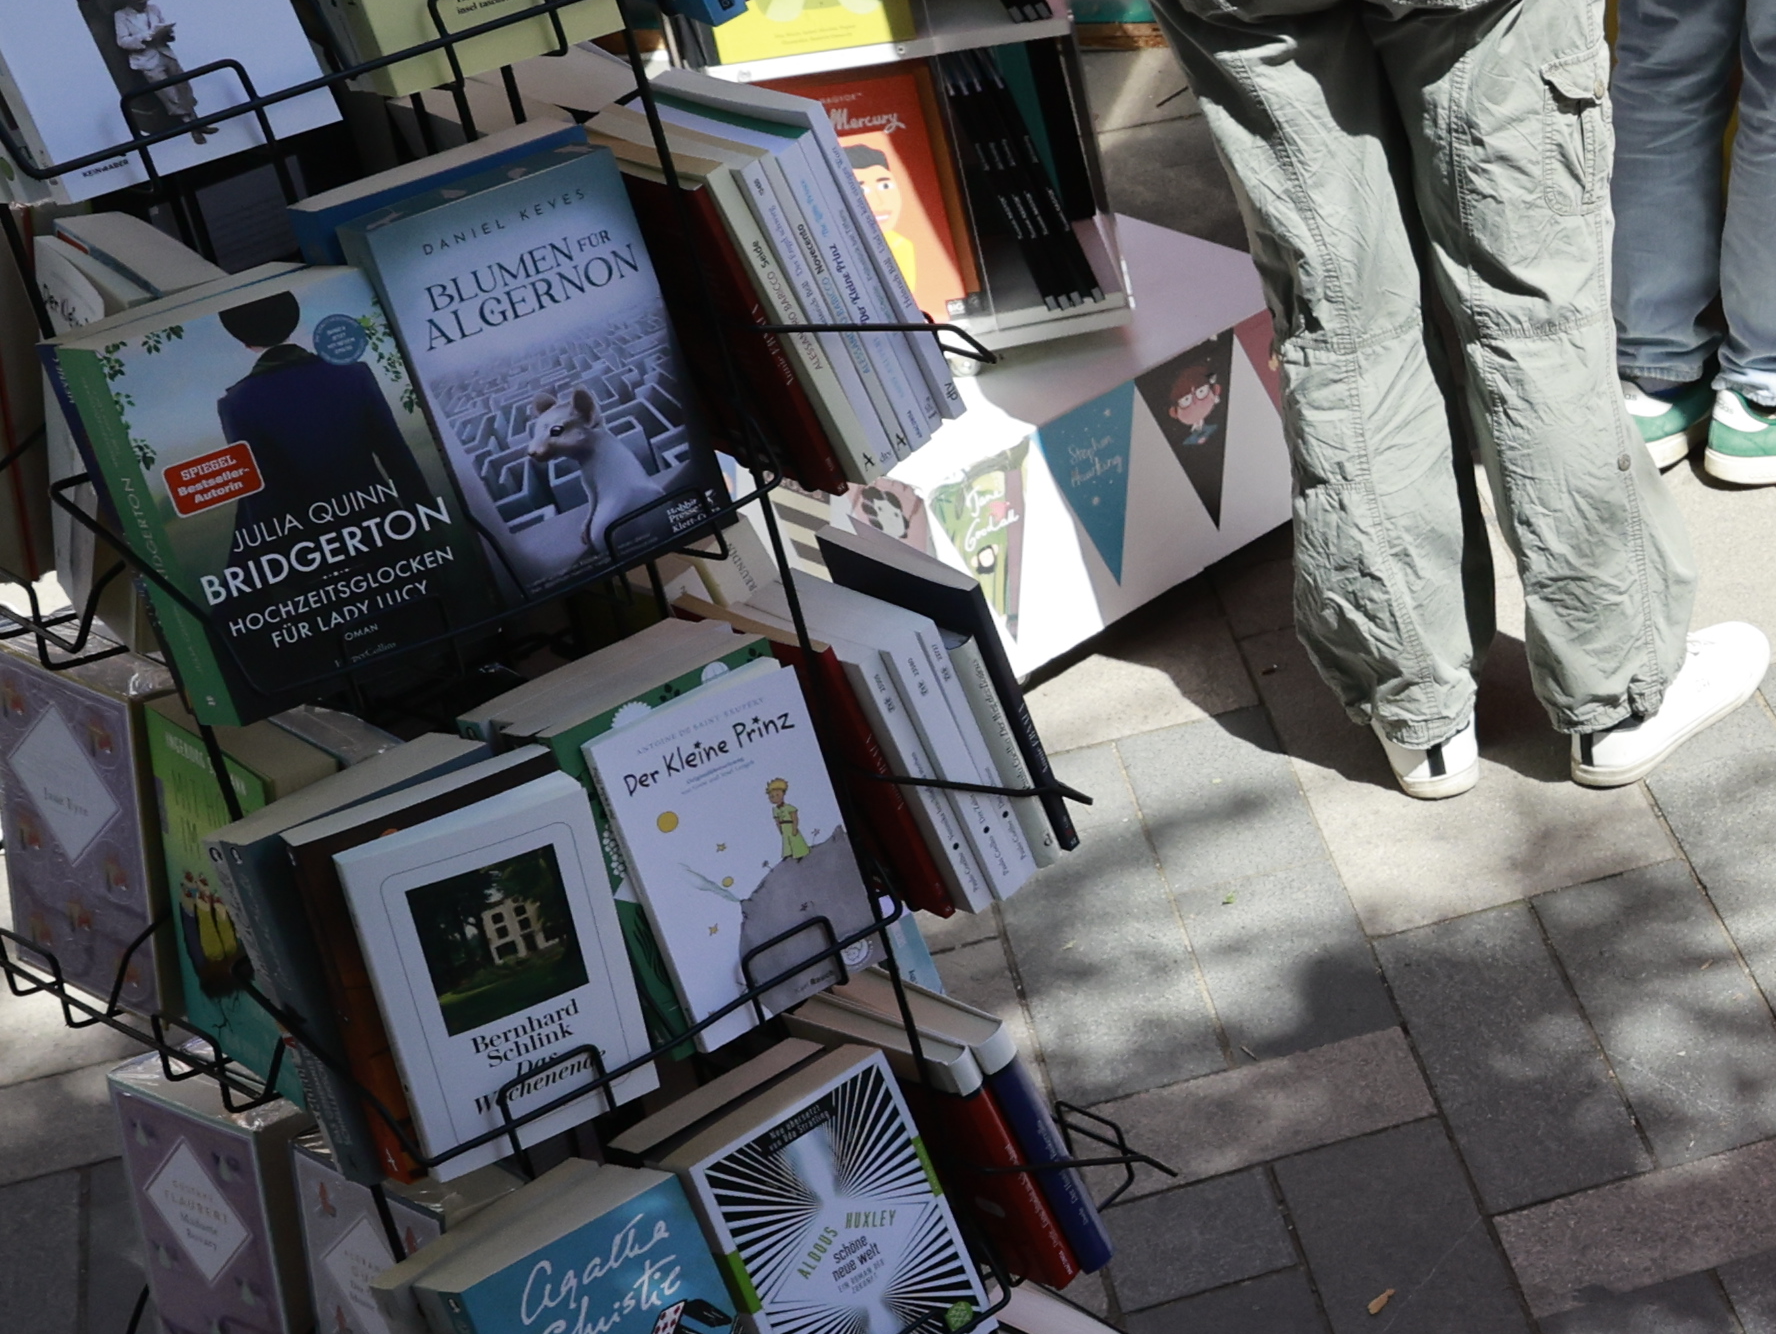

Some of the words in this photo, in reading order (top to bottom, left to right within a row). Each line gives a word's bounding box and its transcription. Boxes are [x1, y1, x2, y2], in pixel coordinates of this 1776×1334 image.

[829, 109, 905, 133] Mercury
[423, 221, 505, 256] DANIEL
[520, 188, 586, 221] KEYES
[424, 237, 574, 313] BLUMEN
[577, 229, 612, 253] FÜR
[426, 243, 641, 352] ALGERNON
[200, 497, 452, 606] BRIDGERTON
[234, 514, 304, 553] JULIA
[308, 479, 398, 523] QUINN
[228, 546, 454, 637] HOCHZEITSGLOCKEN
[271, 623, 313, 649] FÜR
[316, 599, 369, 632] LADY
[623, 770, 660, 797] Der
[662, 741, 730, 773] Kleine
[731, 712, 796, 749] Prinz
[471, 999, 580, 1054] Bernhard
[487, 1021, 574, 1069] Schlink
[520, 1213, 670, 1325] Agatha
[797, 1225, 839, 1280] ALDOUS
[844, 1209, 898, 1229] HUXLEY
